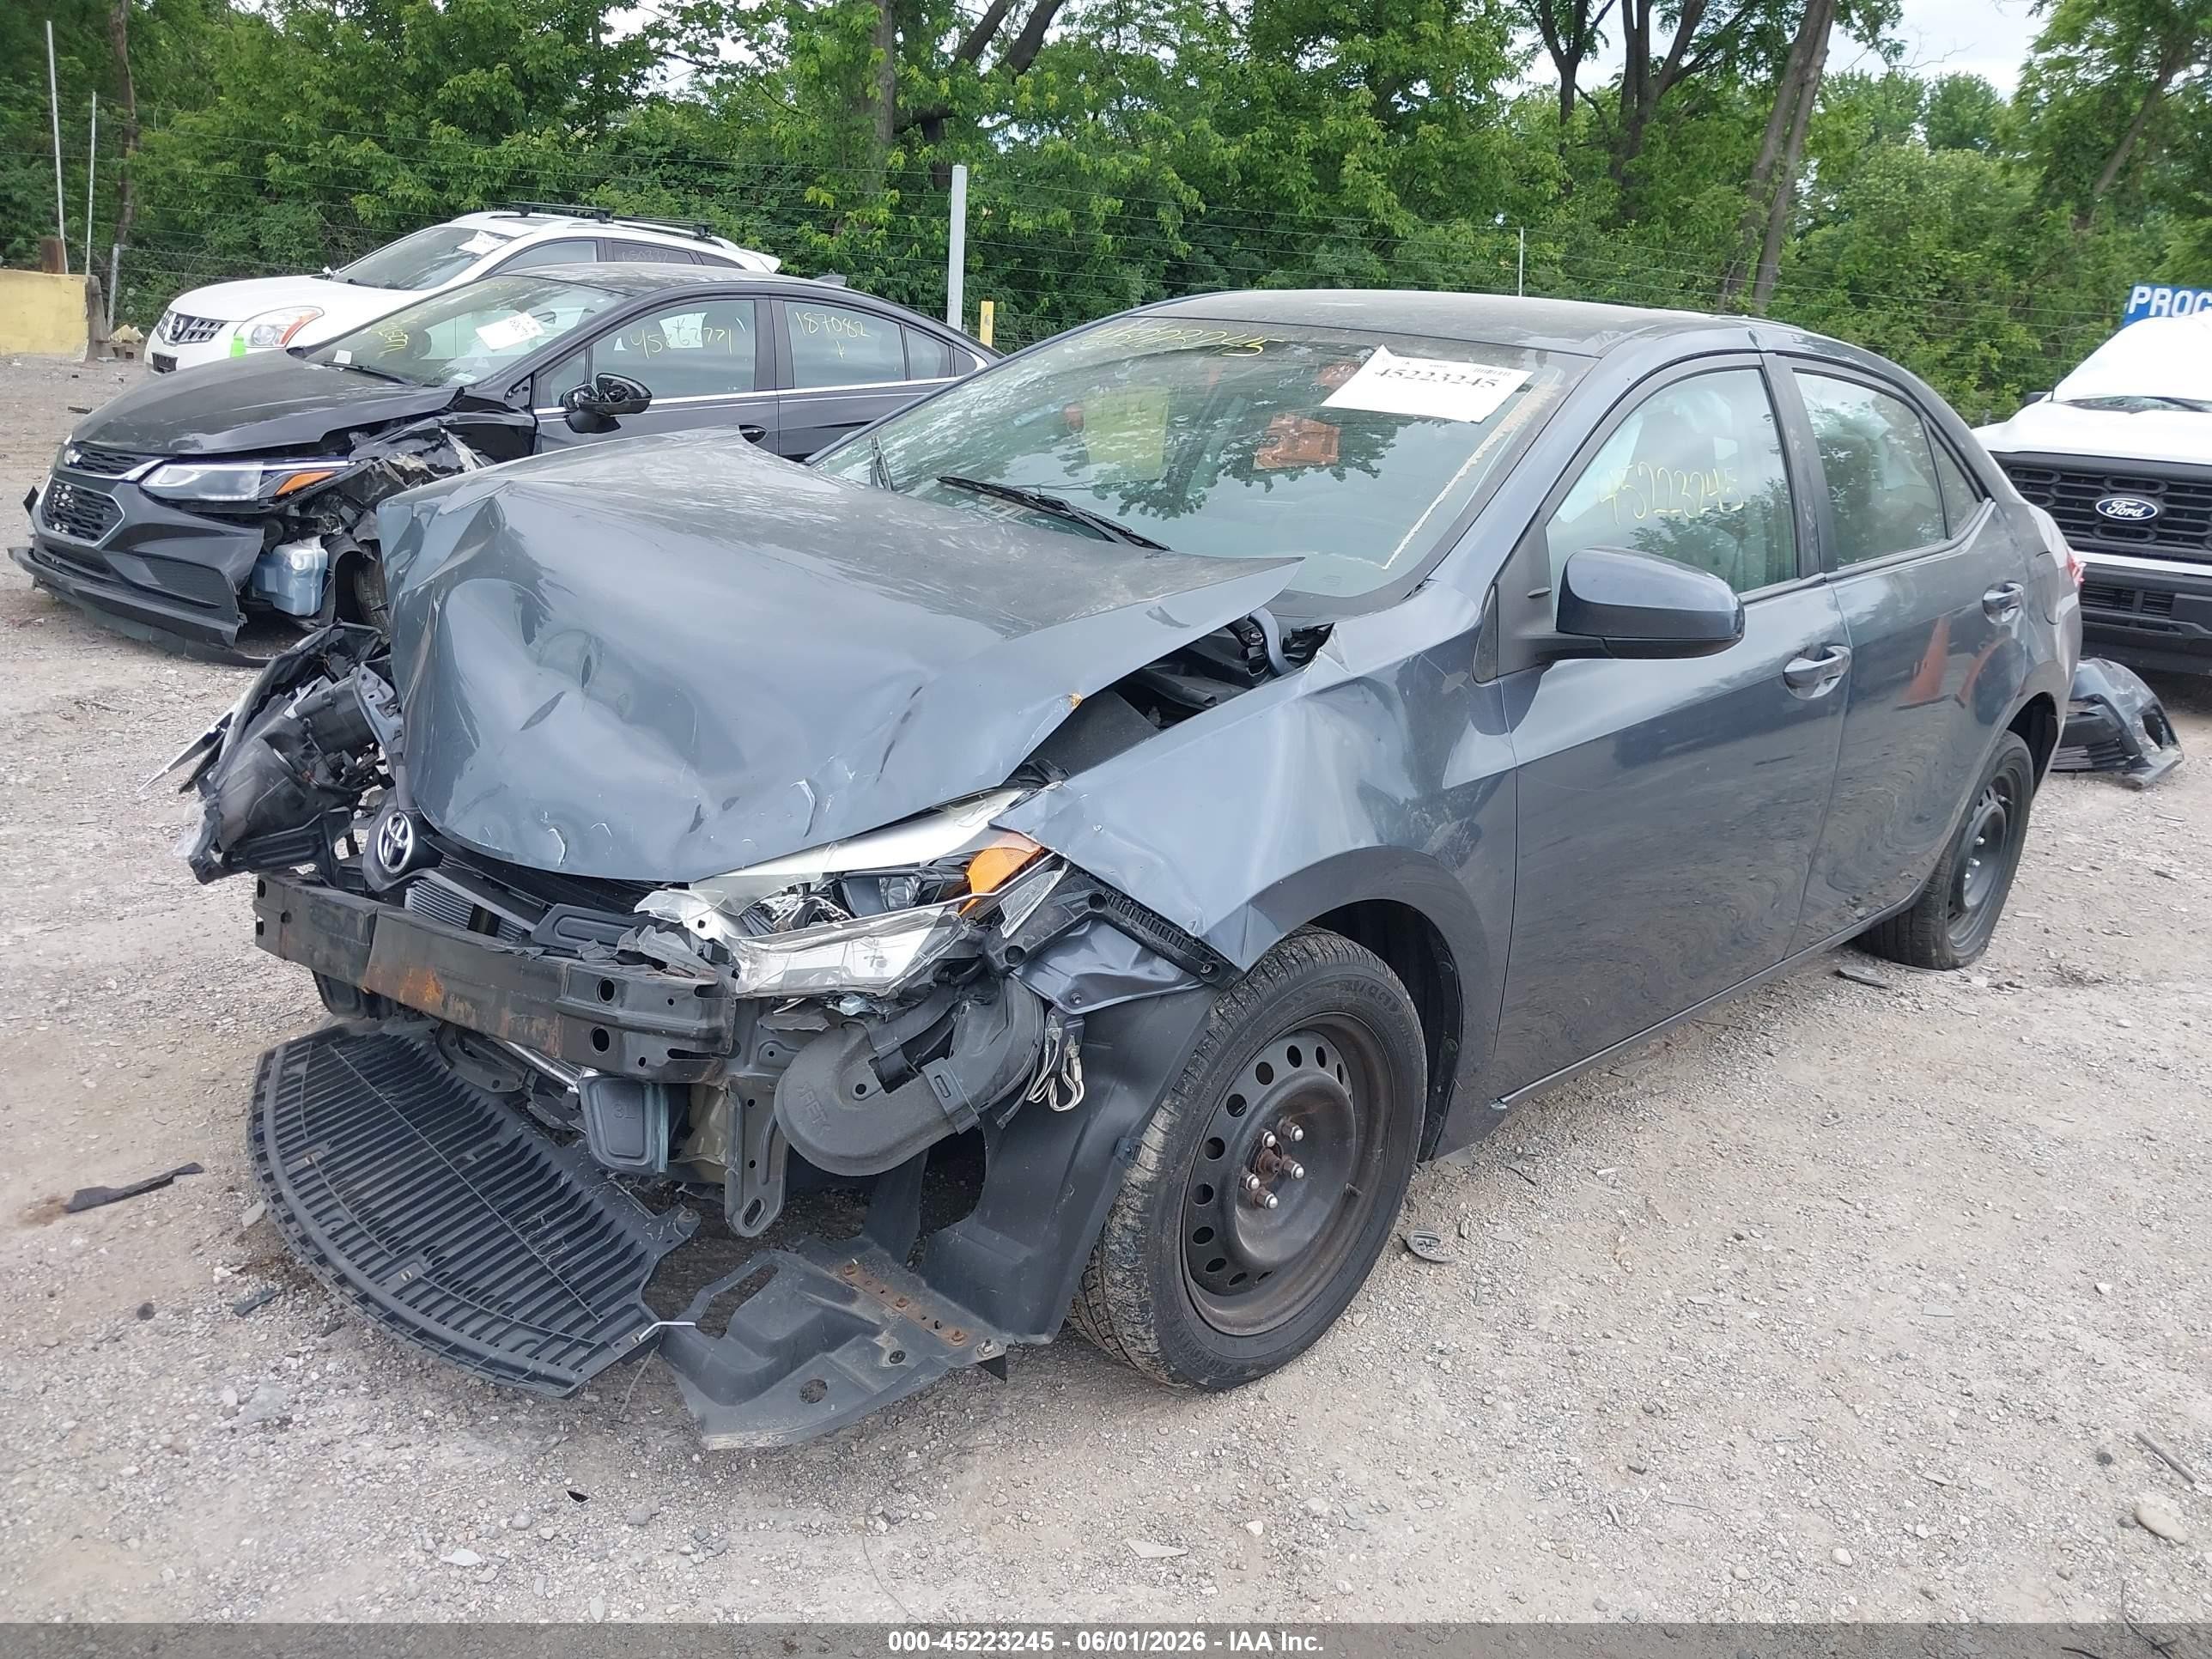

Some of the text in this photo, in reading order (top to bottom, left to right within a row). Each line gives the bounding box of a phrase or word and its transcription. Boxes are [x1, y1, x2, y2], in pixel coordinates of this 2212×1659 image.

[2128, 286, 2212, 318] PROC
[795, 311, 872, 337] 187082
[1374, 368, 1500, 388] 45223245
[2106, 500, 2148, 518] Ford
